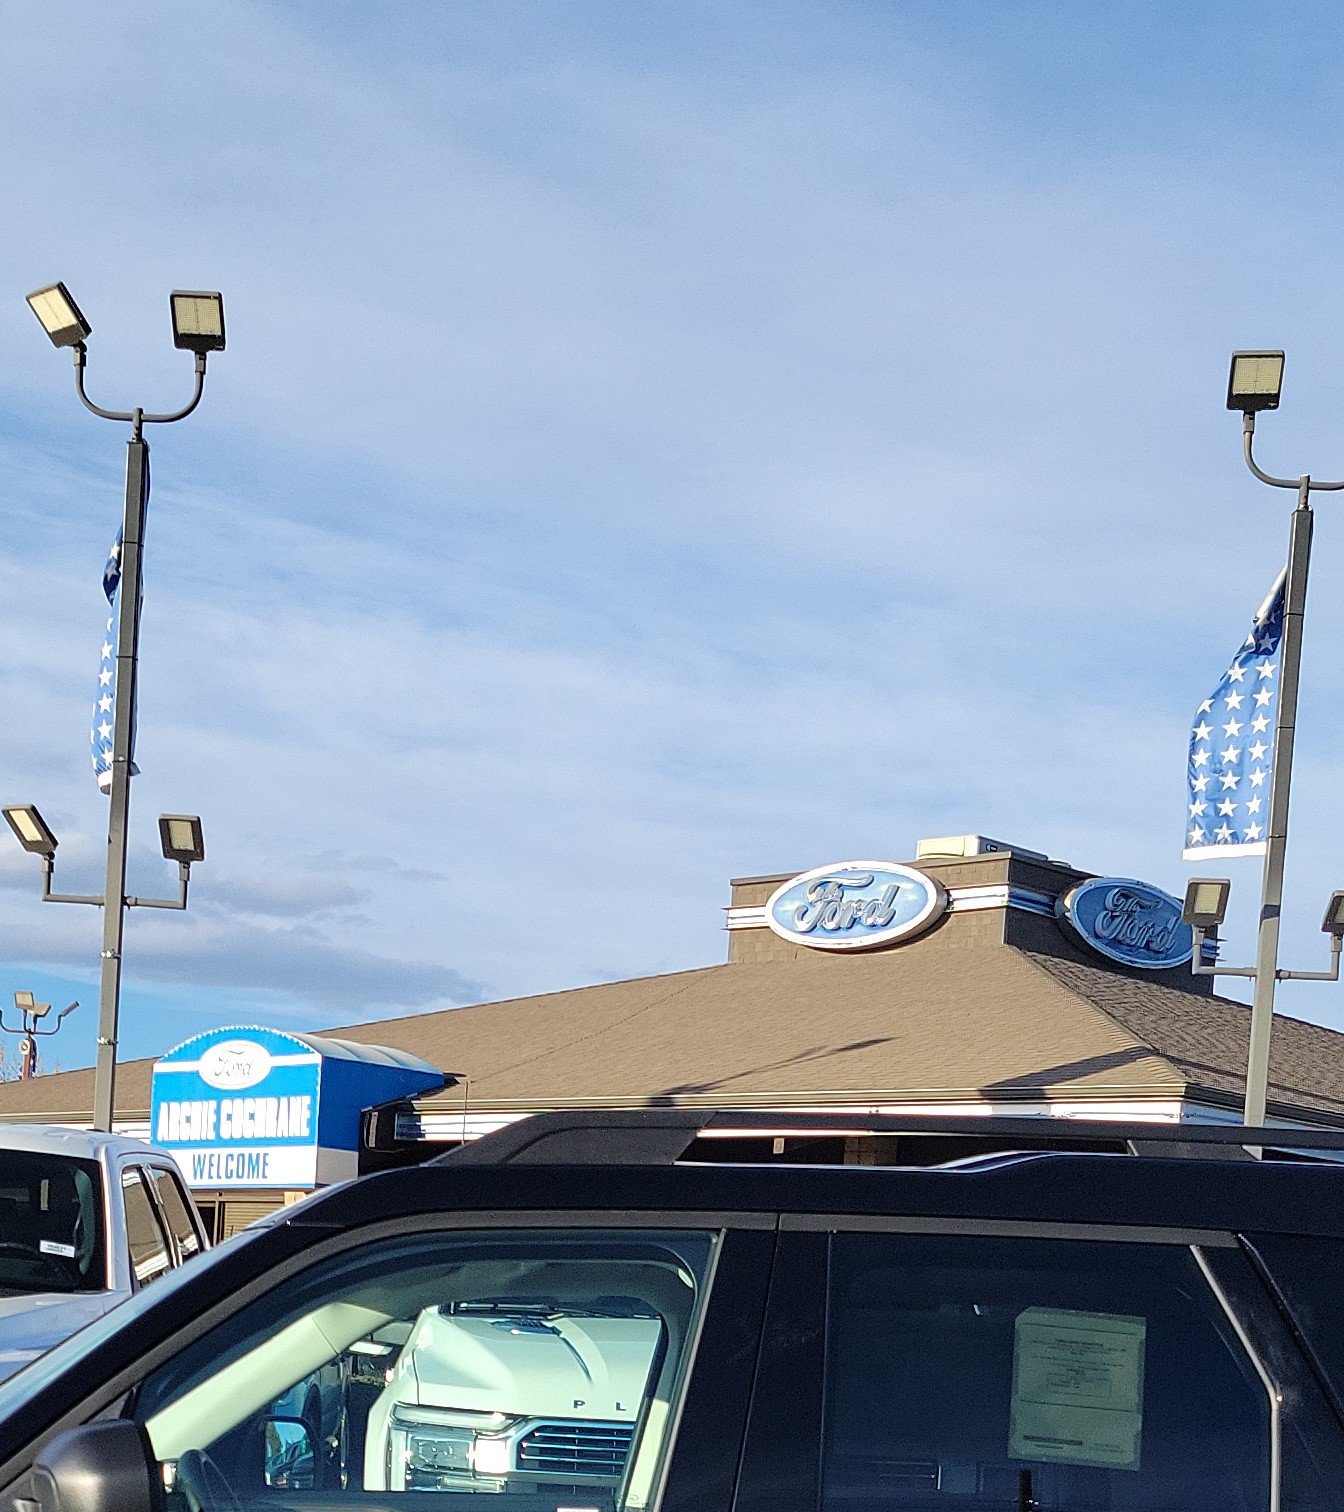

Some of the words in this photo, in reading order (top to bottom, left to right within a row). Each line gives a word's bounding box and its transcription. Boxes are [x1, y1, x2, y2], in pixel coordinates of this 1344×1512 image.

[793, 873, 899, 933] Ford
[1094, 887, 1178, 953] Ford
[213, 1049, 254, 1077] Ford
[158, 1101, 216, 1141] ARCHIE
[220, 1097, 311, 1139] COCHRANE
[193, 1153, 269, 1180] WELCOME
